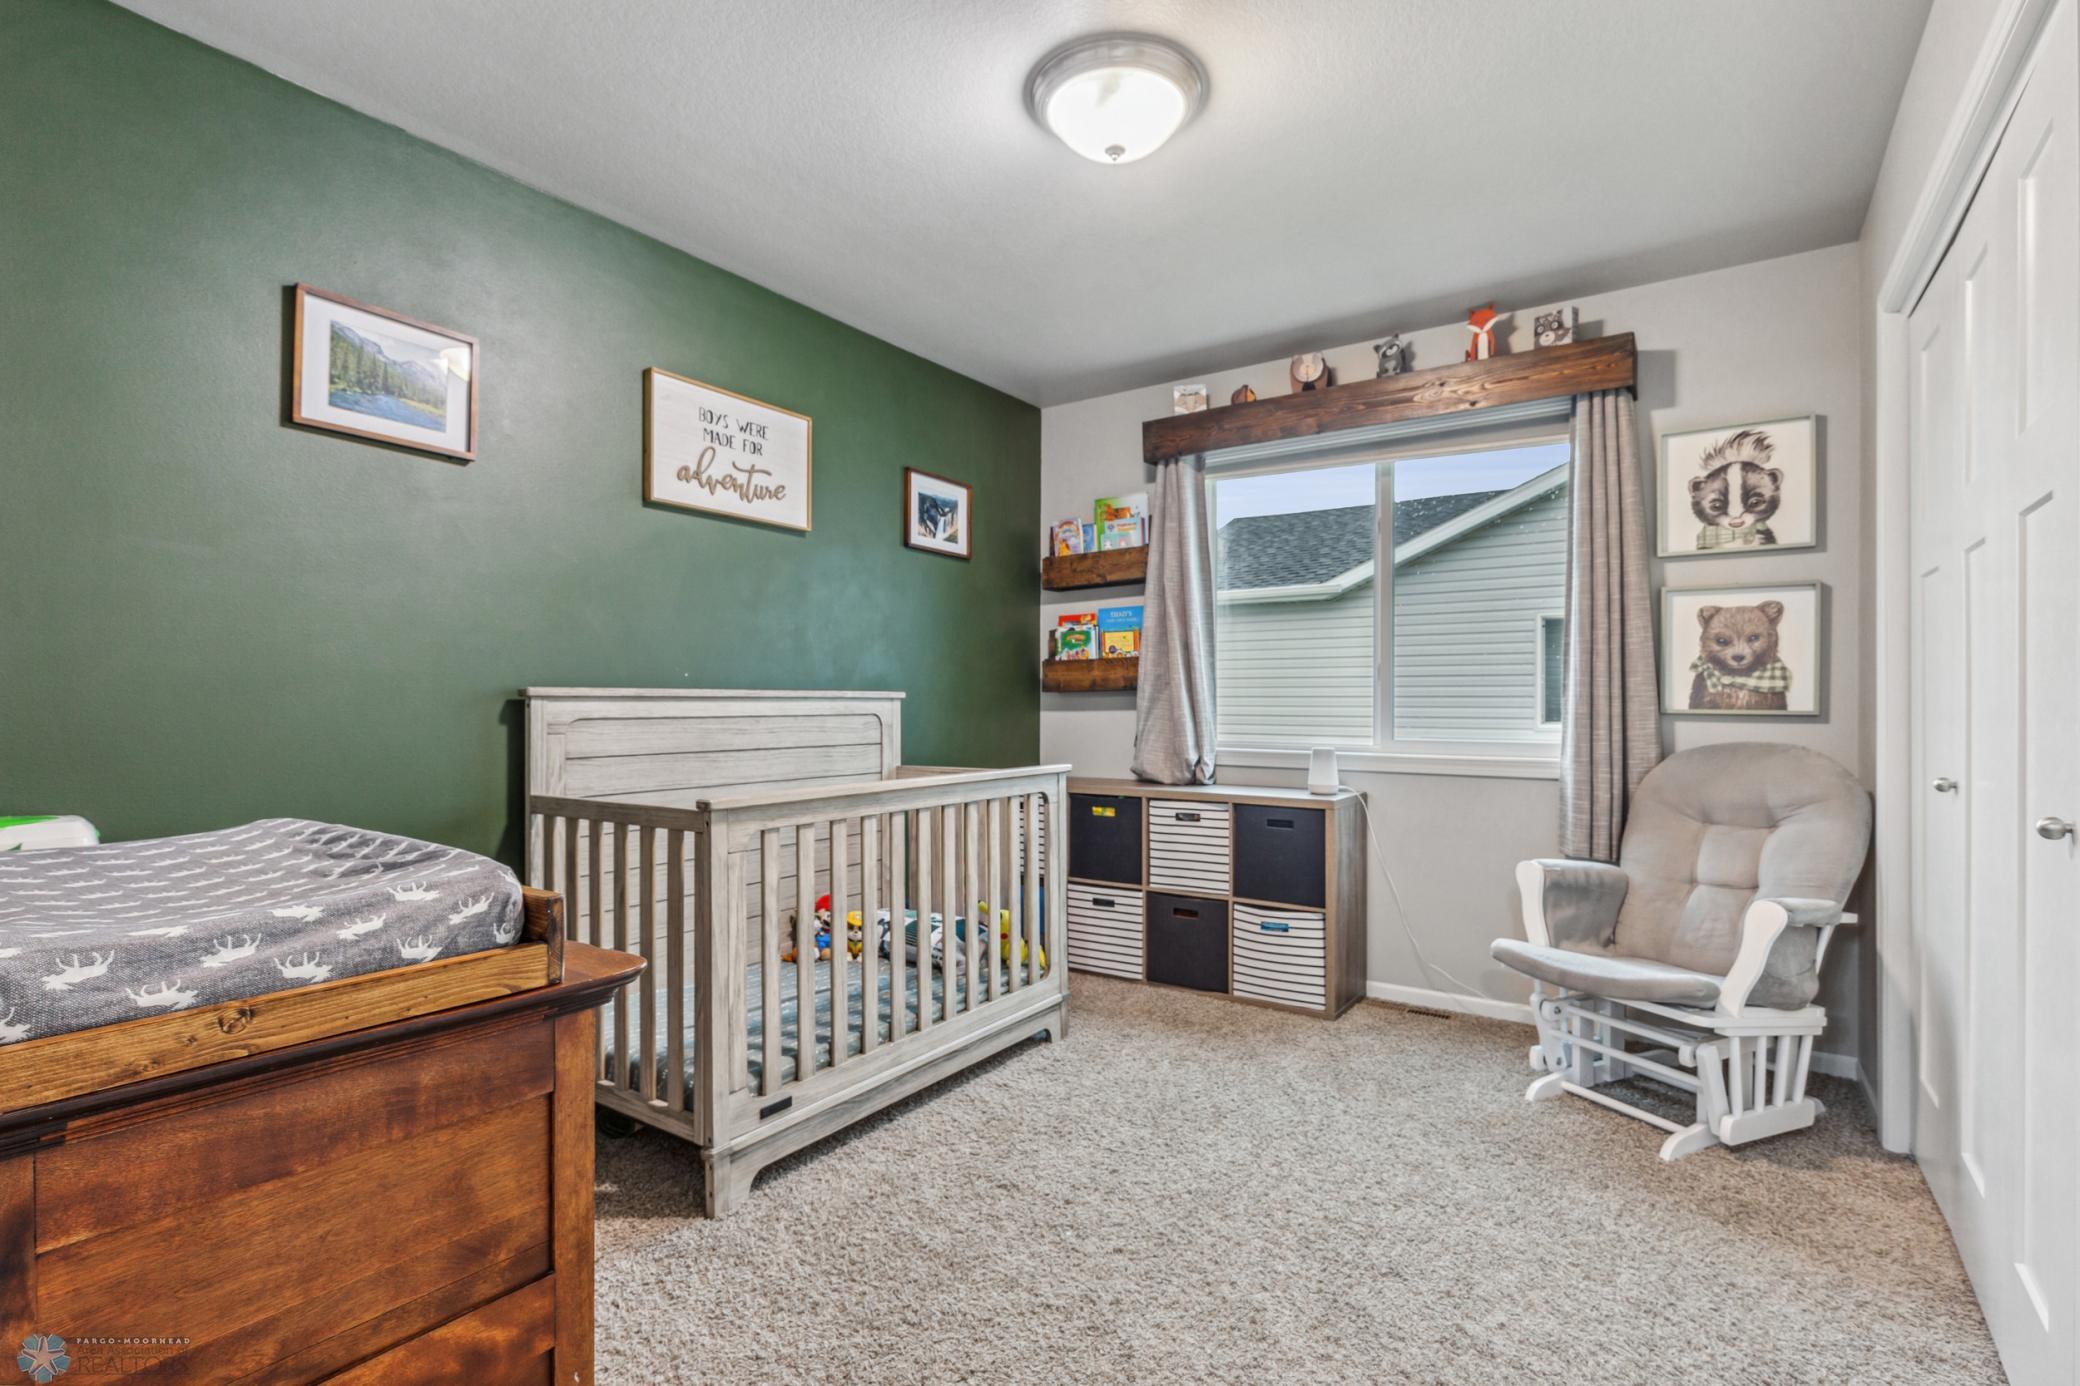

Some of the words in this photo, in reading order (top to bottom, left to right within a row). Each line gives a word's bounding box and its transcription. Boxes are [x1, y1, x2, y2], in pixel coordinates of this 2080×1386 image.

[698, 406, 729, 429] BOYS
[736, 418, 769, 441] WERE
[703, 427, 736, 450] MADE
[742, 439, 764, 456] FOR
[676, 446, 787, 504] adventure
